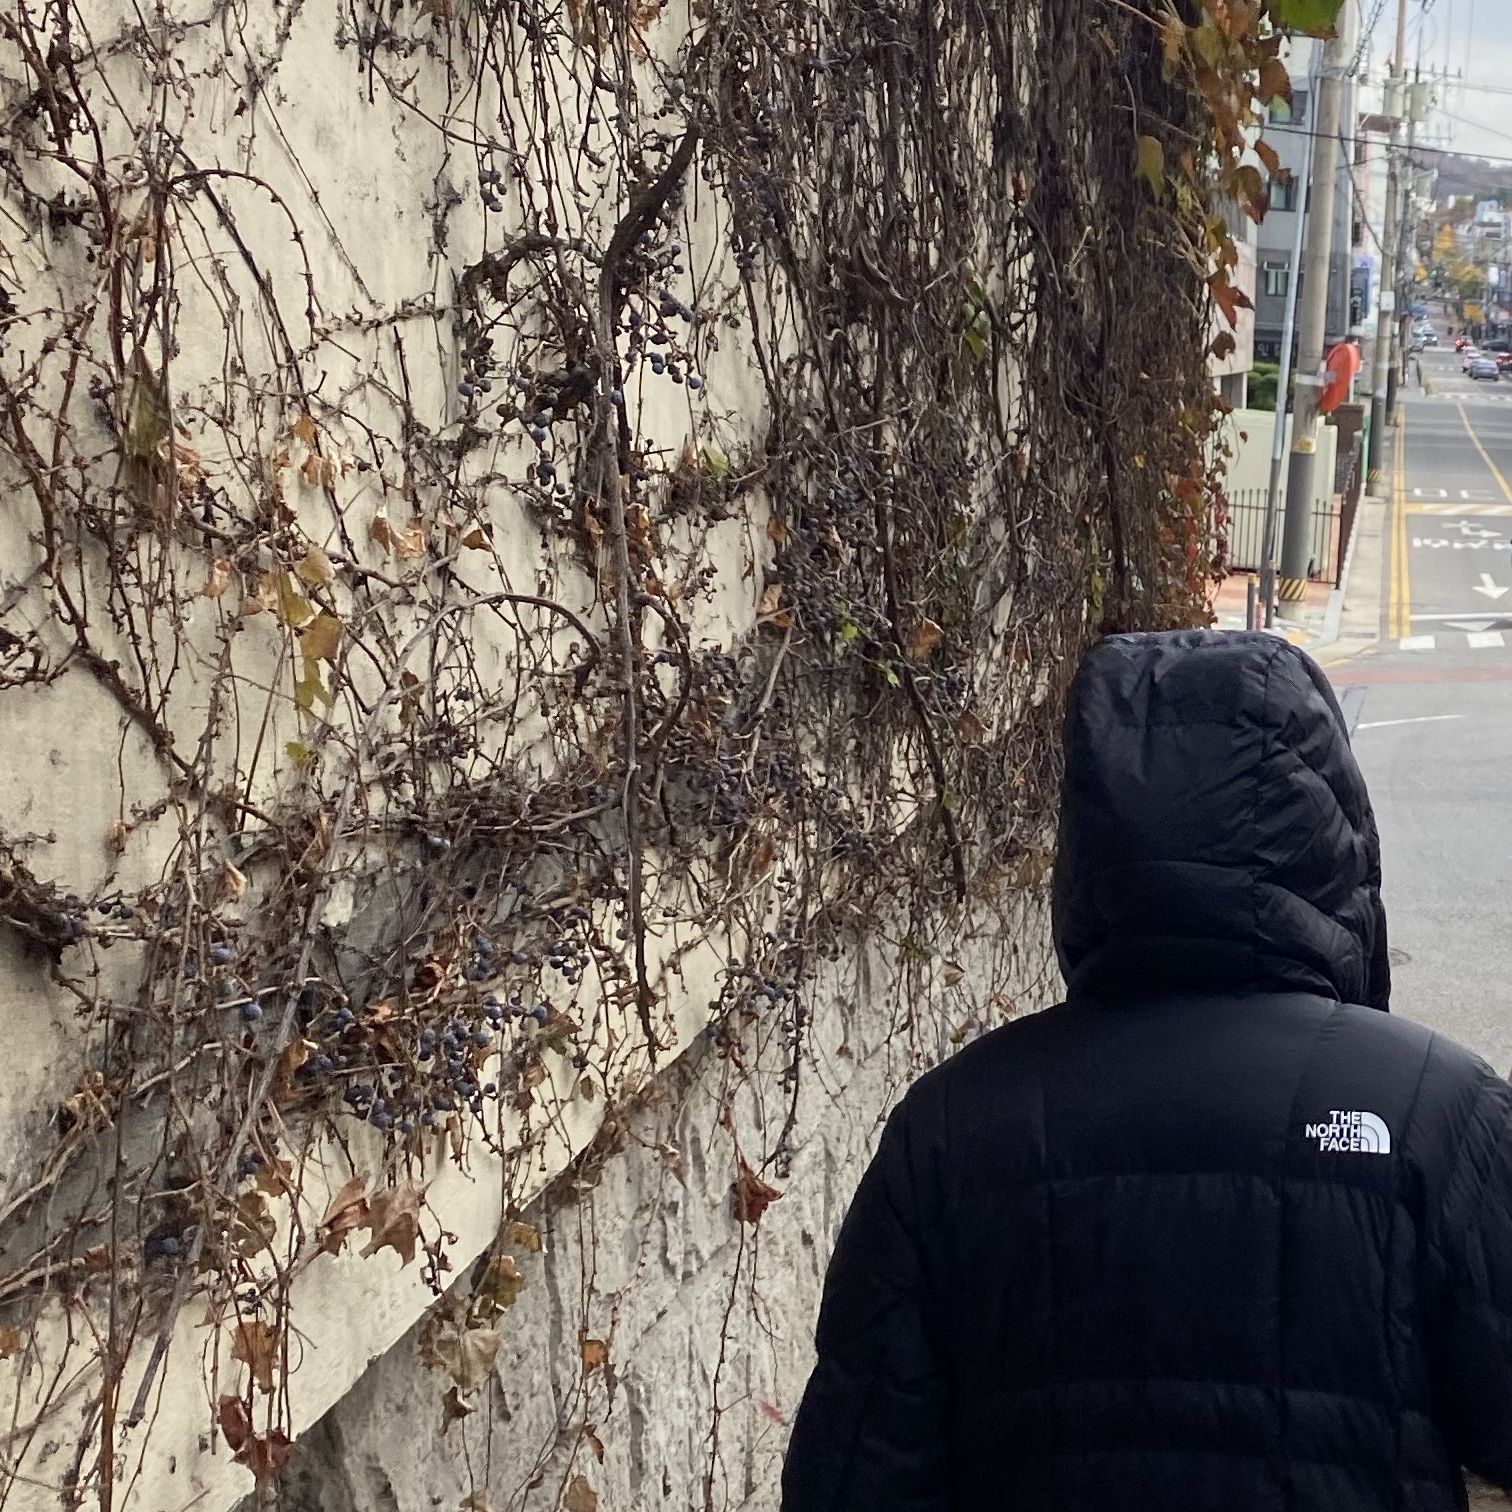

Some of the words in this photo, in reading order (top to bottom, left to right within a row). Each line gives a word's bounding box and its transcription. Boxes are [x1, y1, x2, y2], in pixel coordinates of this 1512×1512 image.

[1329, 1110, 1361, 1124] THE
[1305, 1123, 1361, 1138] NORTH
[1320, 1137, 1361, 1151] FACE
